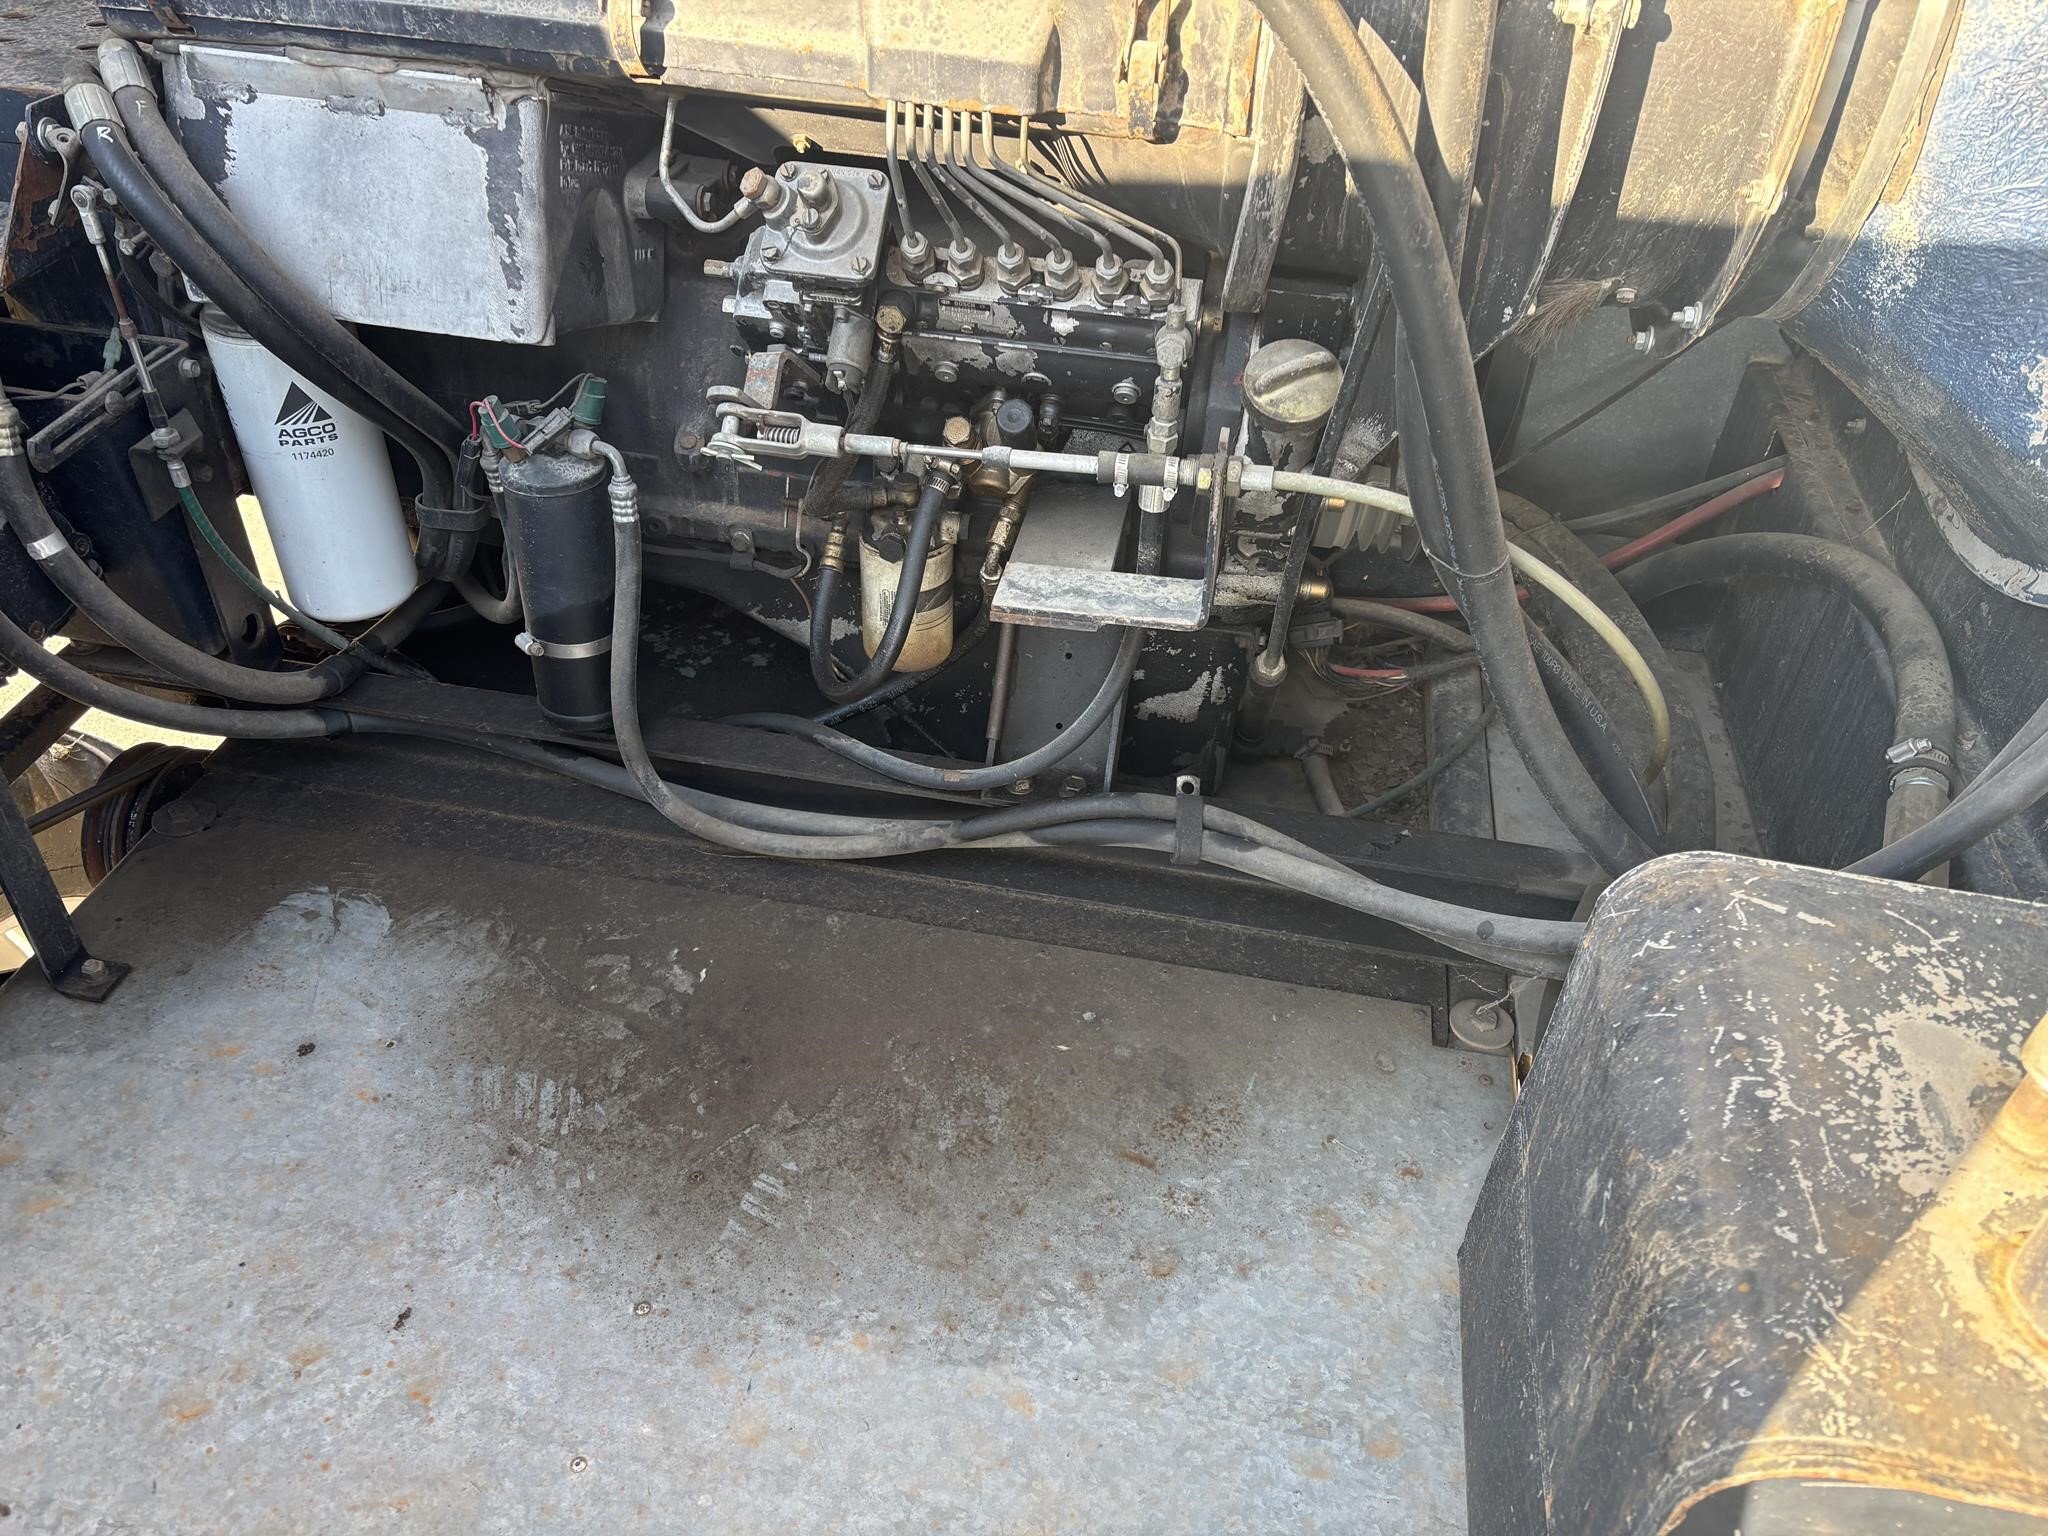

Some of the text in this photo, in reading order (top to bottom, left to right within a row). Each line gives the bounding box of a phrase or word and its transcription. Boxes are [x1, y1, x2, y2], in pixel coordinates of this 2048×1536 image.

[96, 126, 114, 144] R
[278, 422, 337, 439] AGCO
[278, 433, 339, 447] PARTS
[291, 447, 335, 461] 1174420
[1560, 671, 1583, 699] MADE
[1580, 695, 1593, 709] IN
